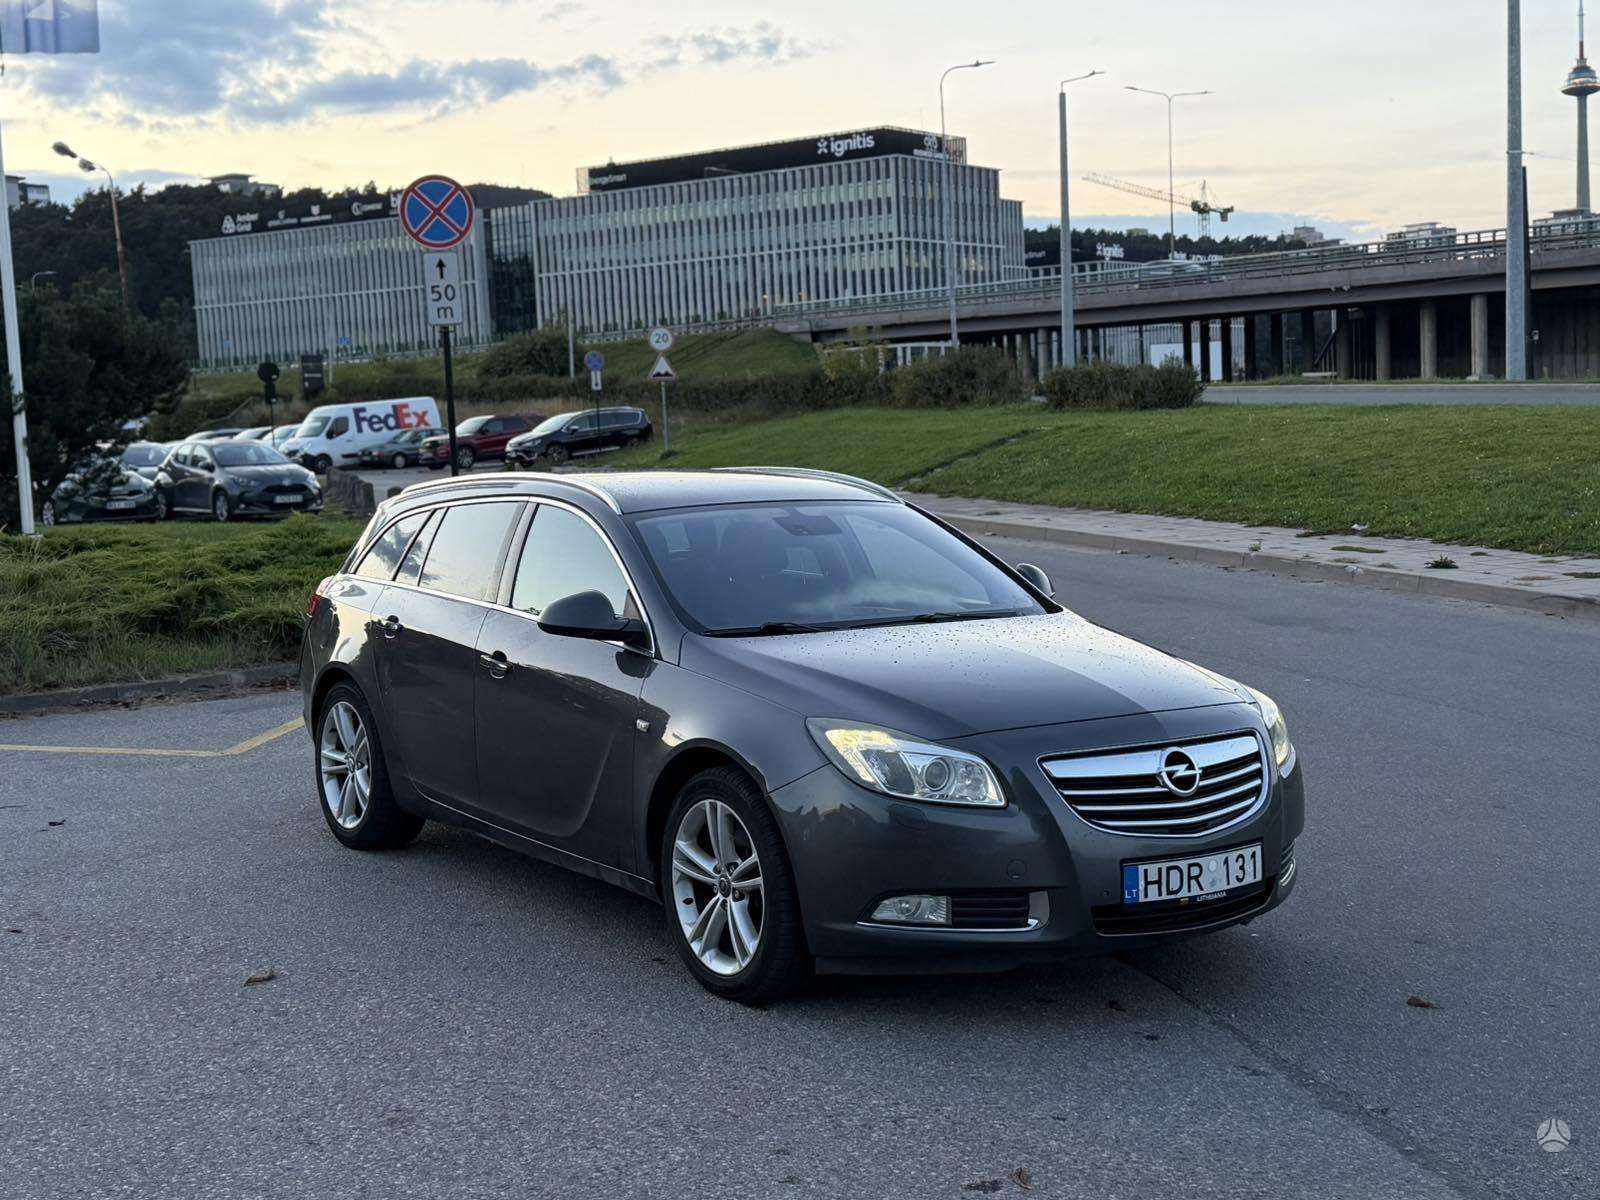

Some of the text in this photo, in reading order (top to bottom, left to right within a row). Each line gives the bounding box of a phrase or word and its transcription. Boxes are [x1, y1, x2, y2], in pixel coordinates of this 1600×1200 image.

[830, 133, 875, 157] ignitis
[430, 284, 456, 302] 50
[437, 305, 454, 319] m
[654, 332, 669, 344] 20
[353, 403, 432, 434] FedEx
[1142, 850, 1258, 899] HDR 131
[1124, 888, 1138, 899] LT
